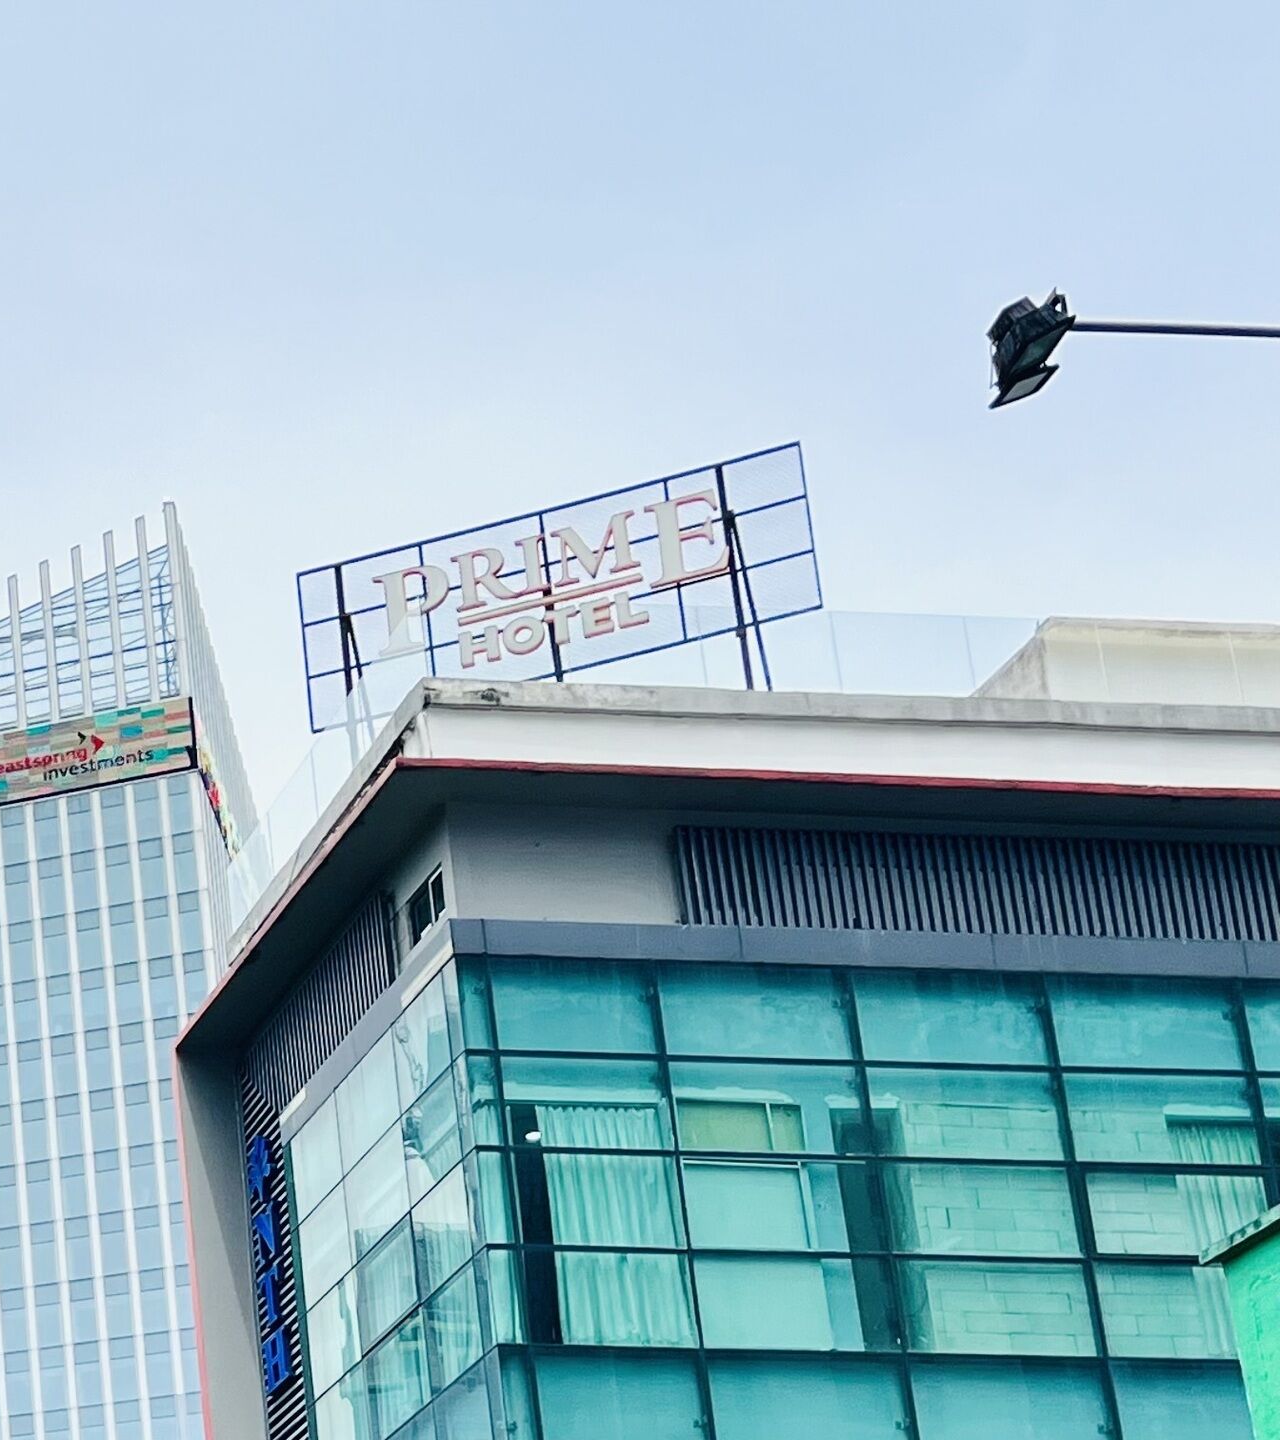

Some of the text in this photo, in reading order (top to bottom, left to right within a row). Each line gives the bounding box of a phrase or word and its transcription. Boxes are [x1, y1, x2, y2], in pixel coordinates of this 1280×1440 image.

[372, 488, 730, 657] PRIME
[458, 591, 650, 668] HOTEL
[43, 749, 155, 781] investments
